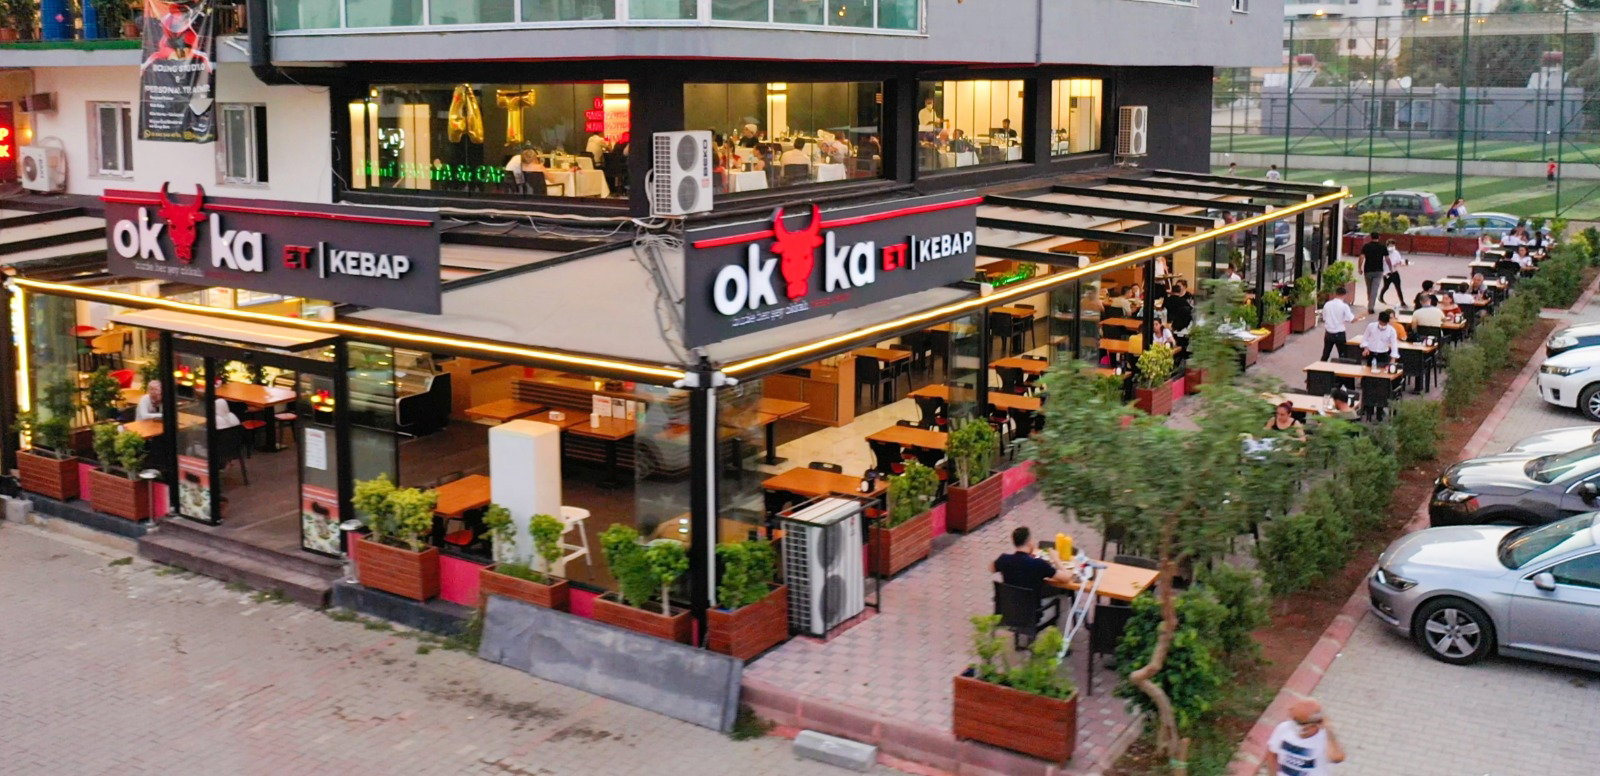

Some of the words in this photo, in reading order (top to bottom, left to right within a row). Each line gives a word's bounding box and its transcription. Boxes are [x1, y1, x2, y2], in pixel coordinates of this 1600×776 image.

[283, 244, 312, 269] ET
[330, 249, 410, 279] KEBAP
[882, 243, 909, 272] ET
[920, 230, 973, 263] KEBAP
